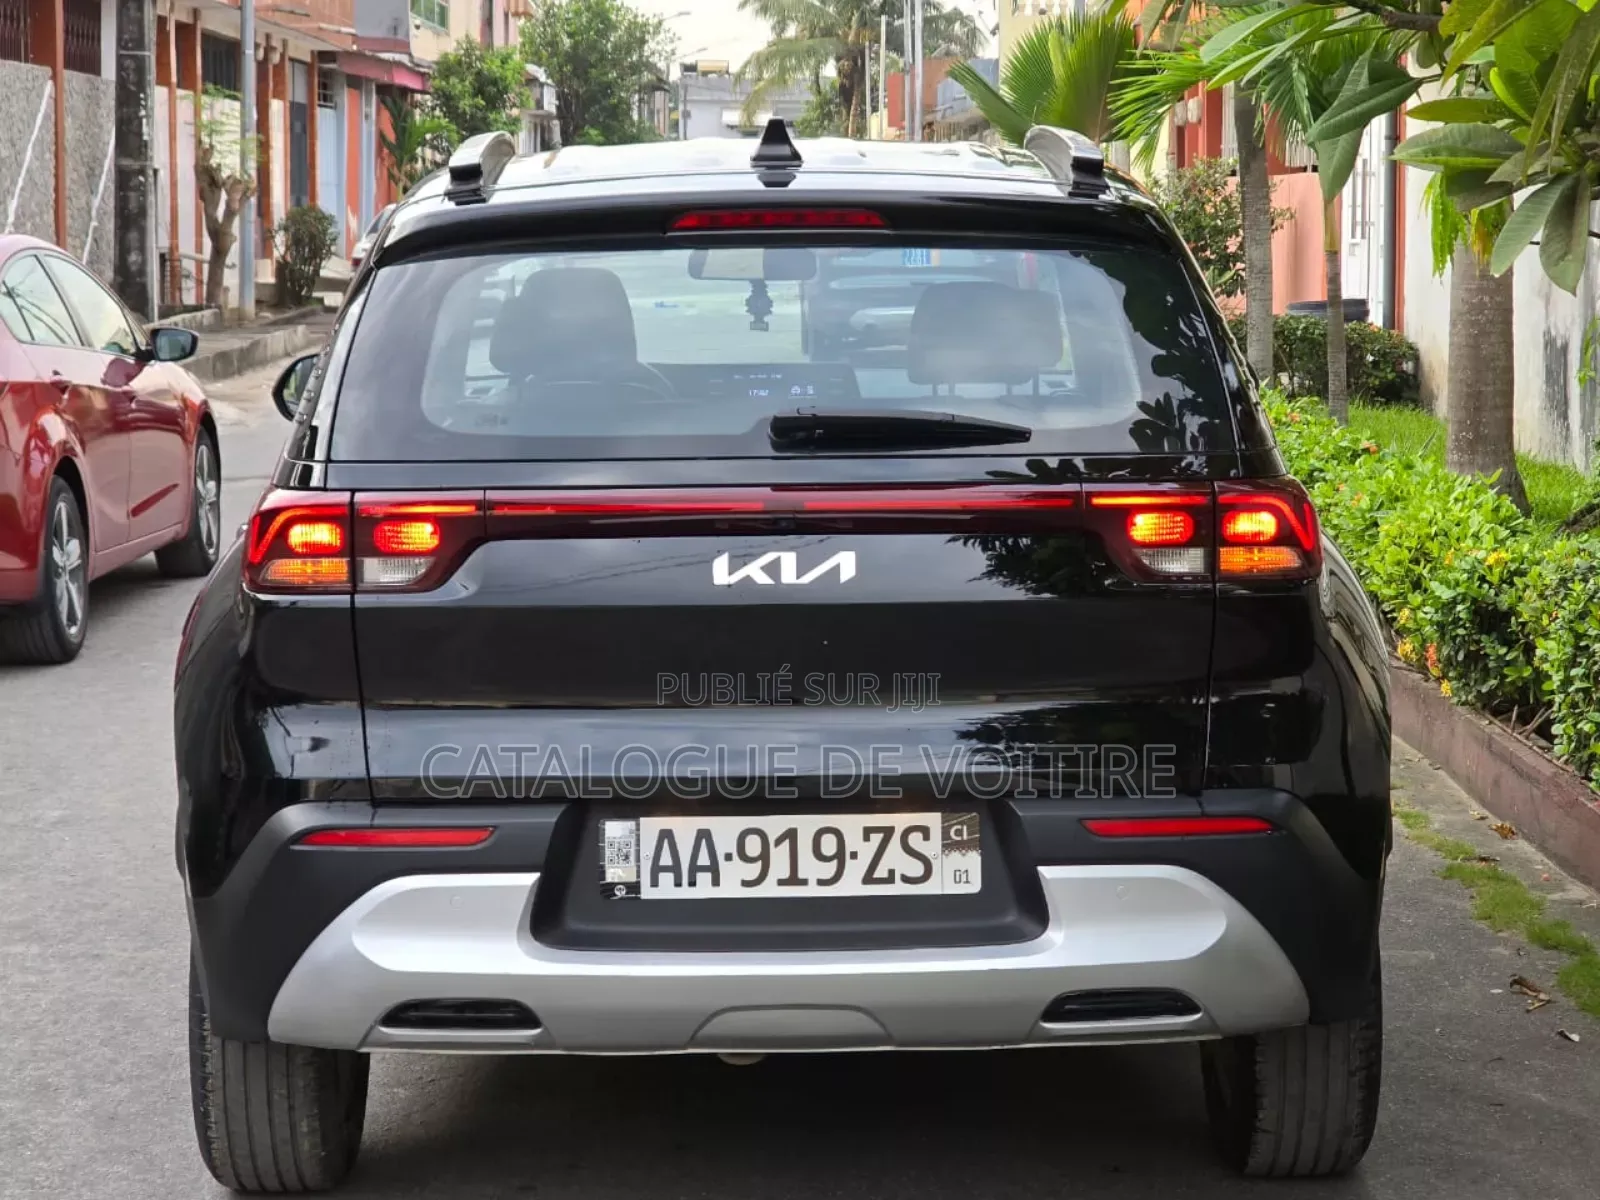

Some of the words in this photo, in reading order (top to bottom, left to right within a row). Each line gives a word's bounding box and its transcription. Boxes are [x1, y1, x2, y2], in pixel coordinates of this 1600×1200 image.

[712, 550, 856, 586] KIA
[949, 824, 968, 841] CI
[953, 868, 972, 885] 01
